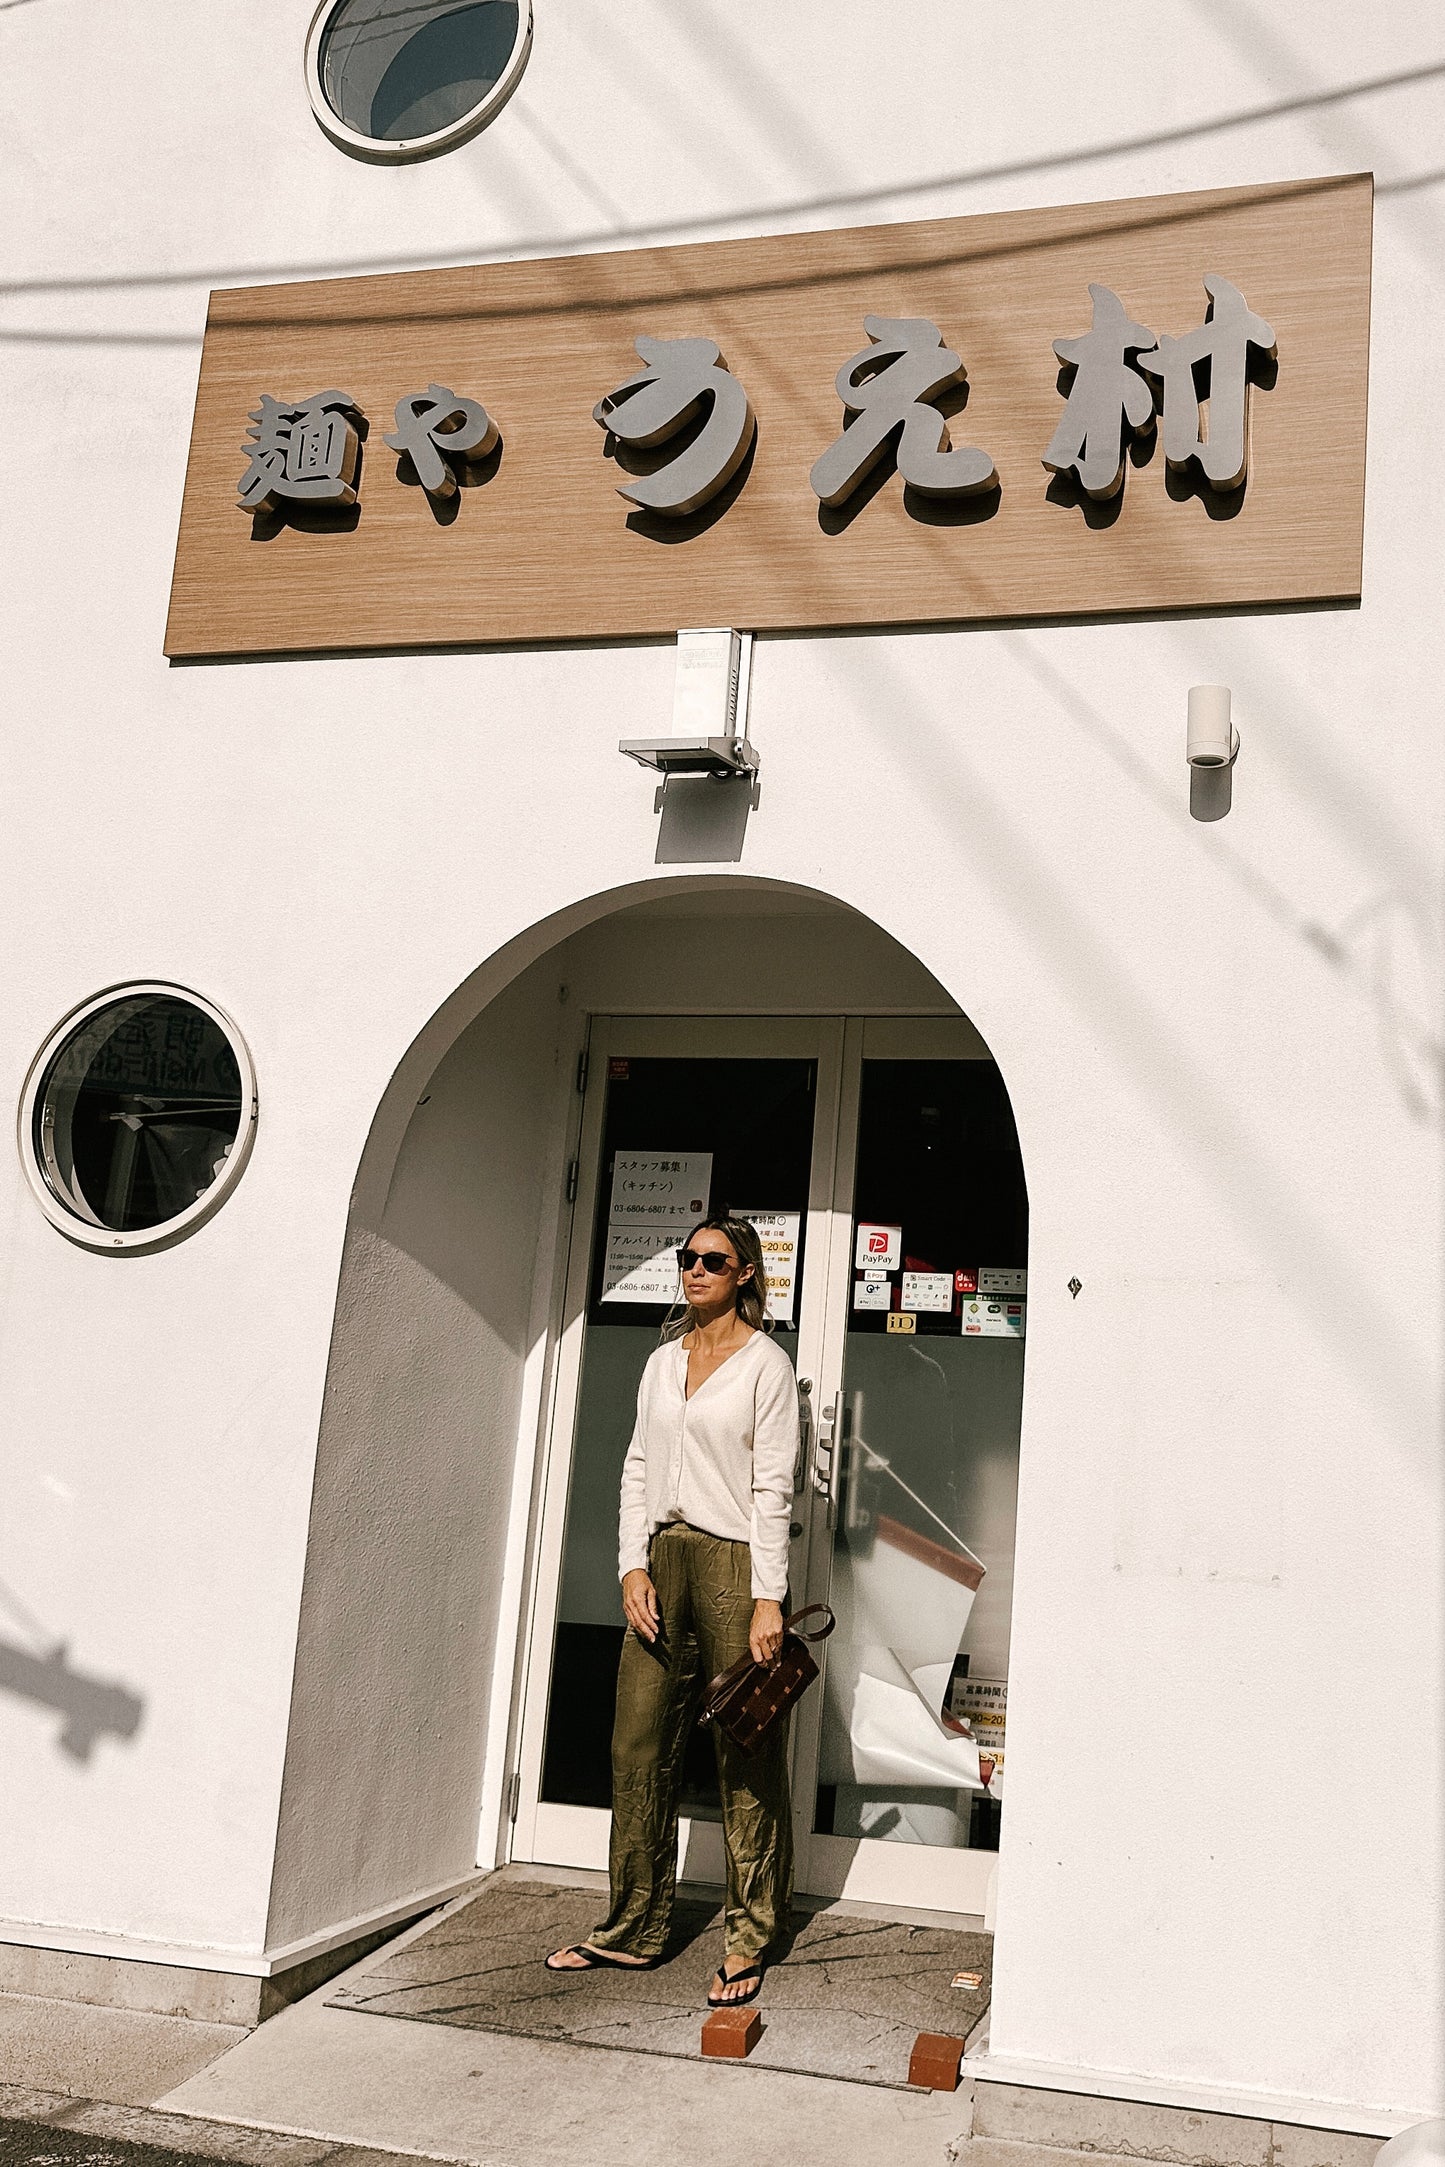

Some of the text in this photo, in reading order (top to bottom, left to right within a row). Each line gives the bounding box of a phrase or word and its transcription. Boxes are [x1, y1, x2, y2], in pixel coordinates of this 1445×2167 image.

[619, 1161, 688, 1172] スタッフ募集！
[614, 1204, 667, 1214] 03-6806-6807
[669, 1206, 686, 1215] まで
[862, 1254, 894, 1264] PayPay
[607, 1282, 659, 1292] 03-6806-6807
[890, 1316, 914, 1330] iD
[966, 1685, 1001, 1697] 営業時間
